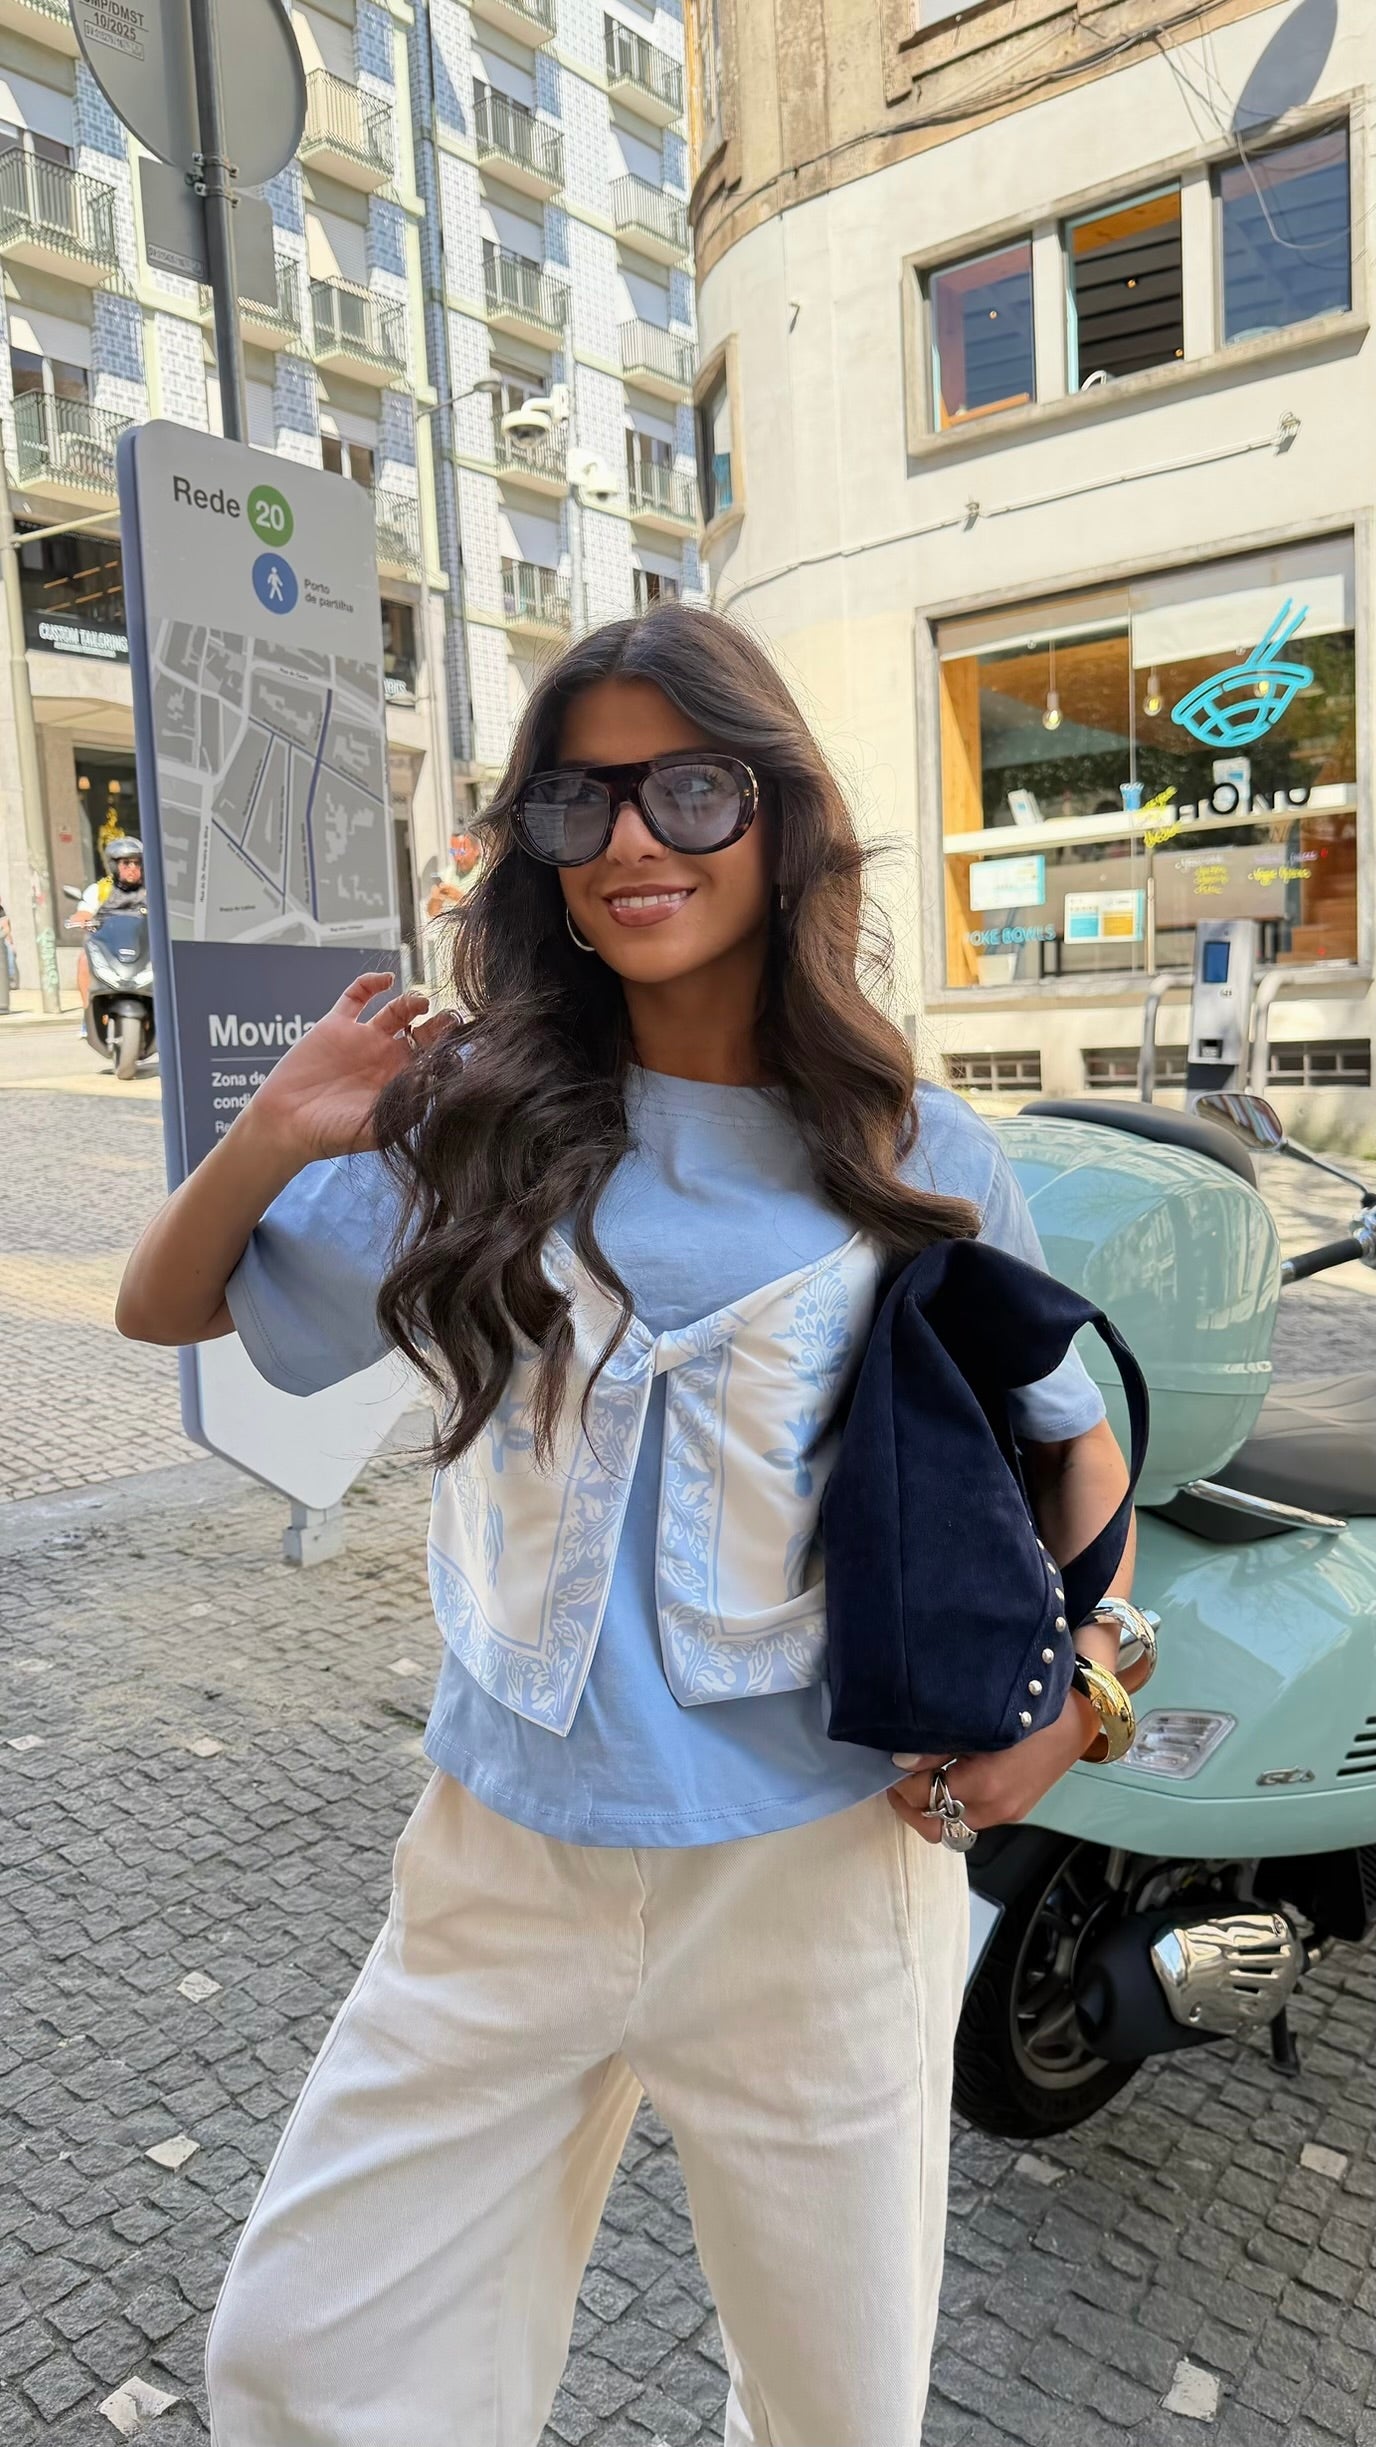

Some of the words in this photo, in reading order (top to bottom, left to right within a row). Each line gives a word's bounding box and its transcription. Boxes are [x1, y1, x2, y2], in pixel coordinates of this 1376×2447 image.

[93, 12, 137, 41] 10/2025
[173, 475, 241, 518] Rede
[255, 500, 285, 532] 20
[1001, 923, 1057, 945] BOWLS
[211, 1071, 247, 1088] Zona
